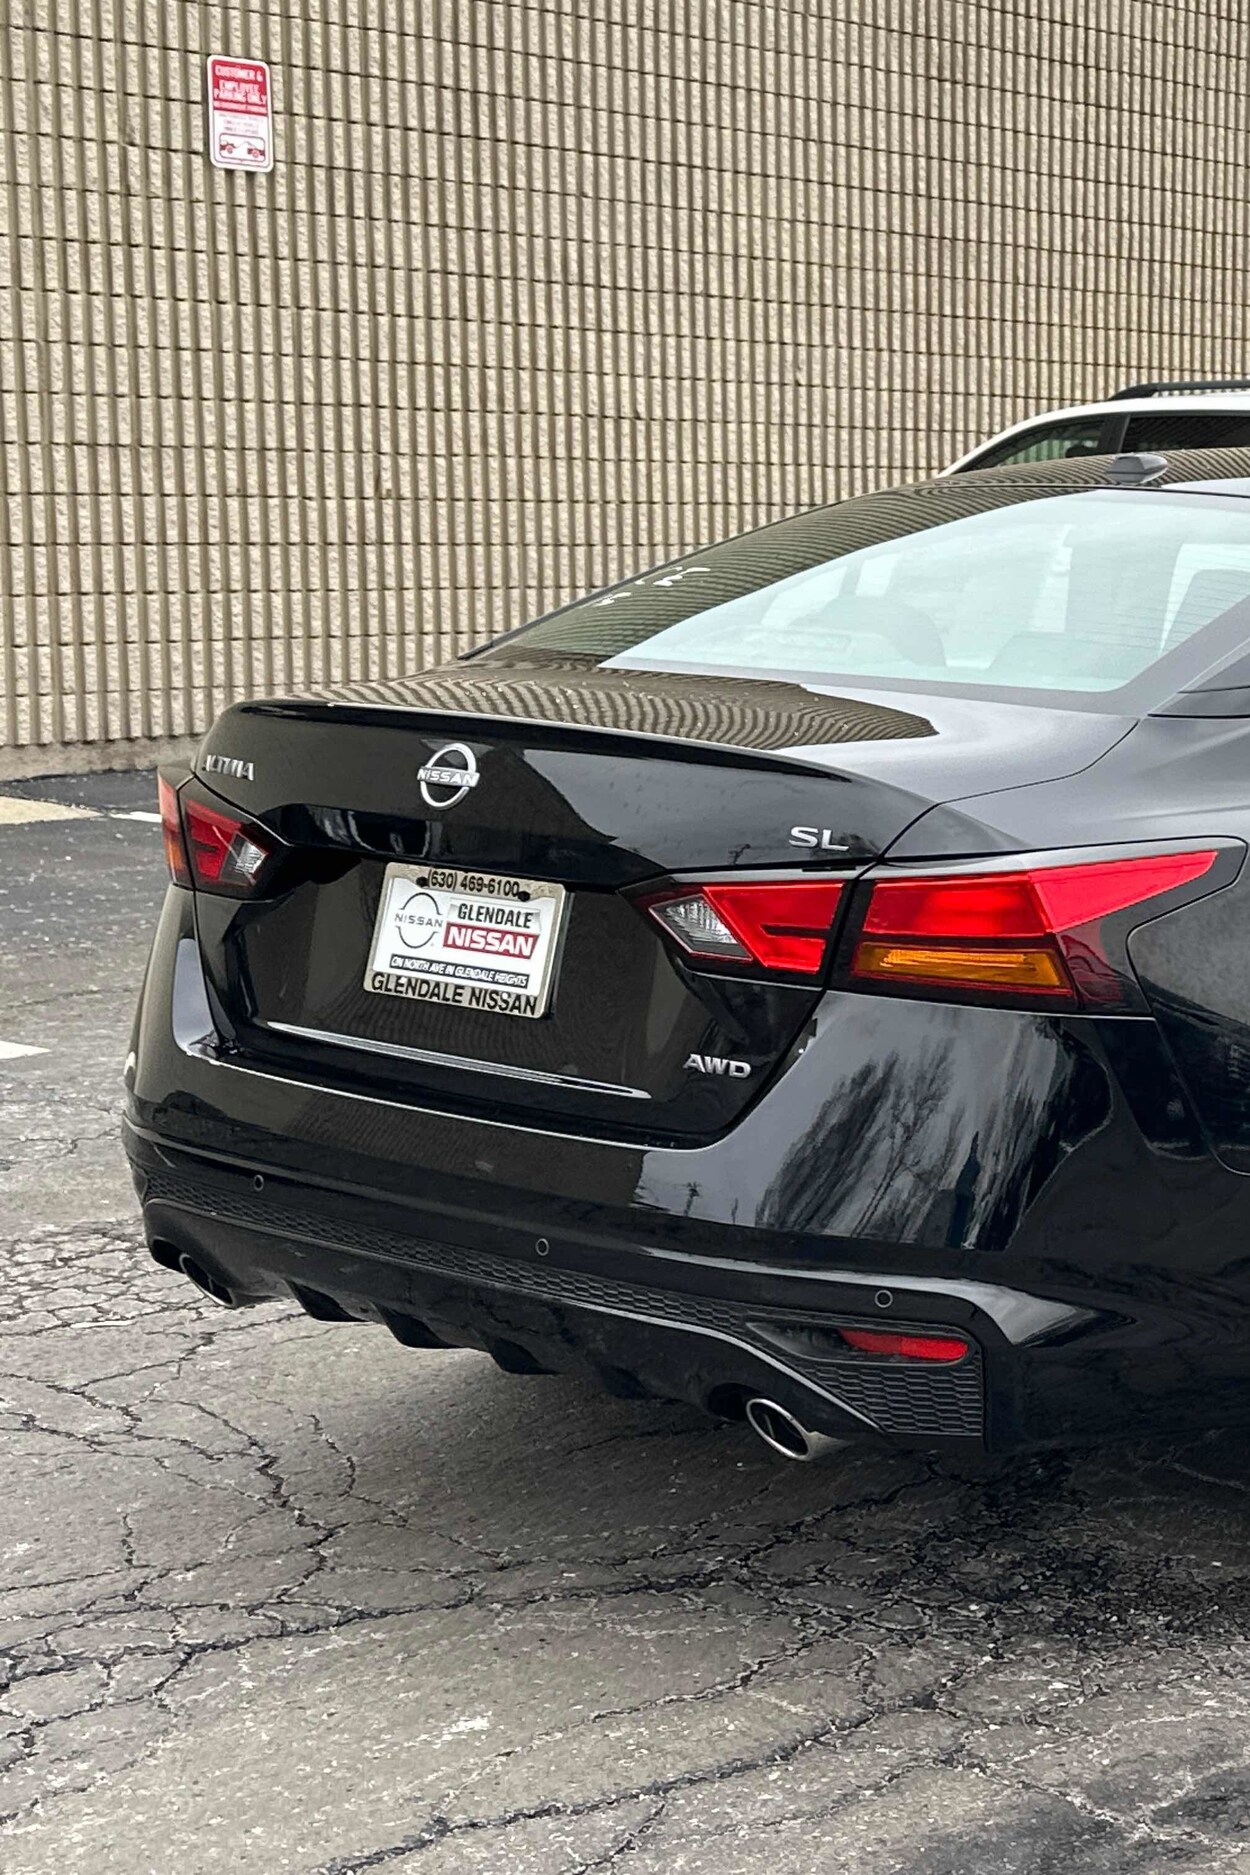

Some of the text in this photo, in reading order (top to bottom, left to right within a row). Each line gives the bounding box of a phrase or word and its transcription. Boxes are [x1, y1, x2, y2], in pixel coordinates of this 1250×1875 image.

[418, 767, 477, 787] NISSAN
[788, 826, 849, 851] SL
[427, 869, 520, 897] (630) 469-6100
[394, 913, 444, 928] NISSAN
[457, 903, 534, 929] GLENDALE
[447, 928, 535, 957] NISSAN
[403, 958, 429, 971] NORTH
[429, 962, 446, 974] AVE
[445, 965, 455, 975] IN
[455, 965, 495, 982] GLENDALE
[495, 971, 527, 987] HEIGHTS
[371, 972, 538, 1016] GLENDALE NISSAN
[683, 1053, 751, 1079] AWD
